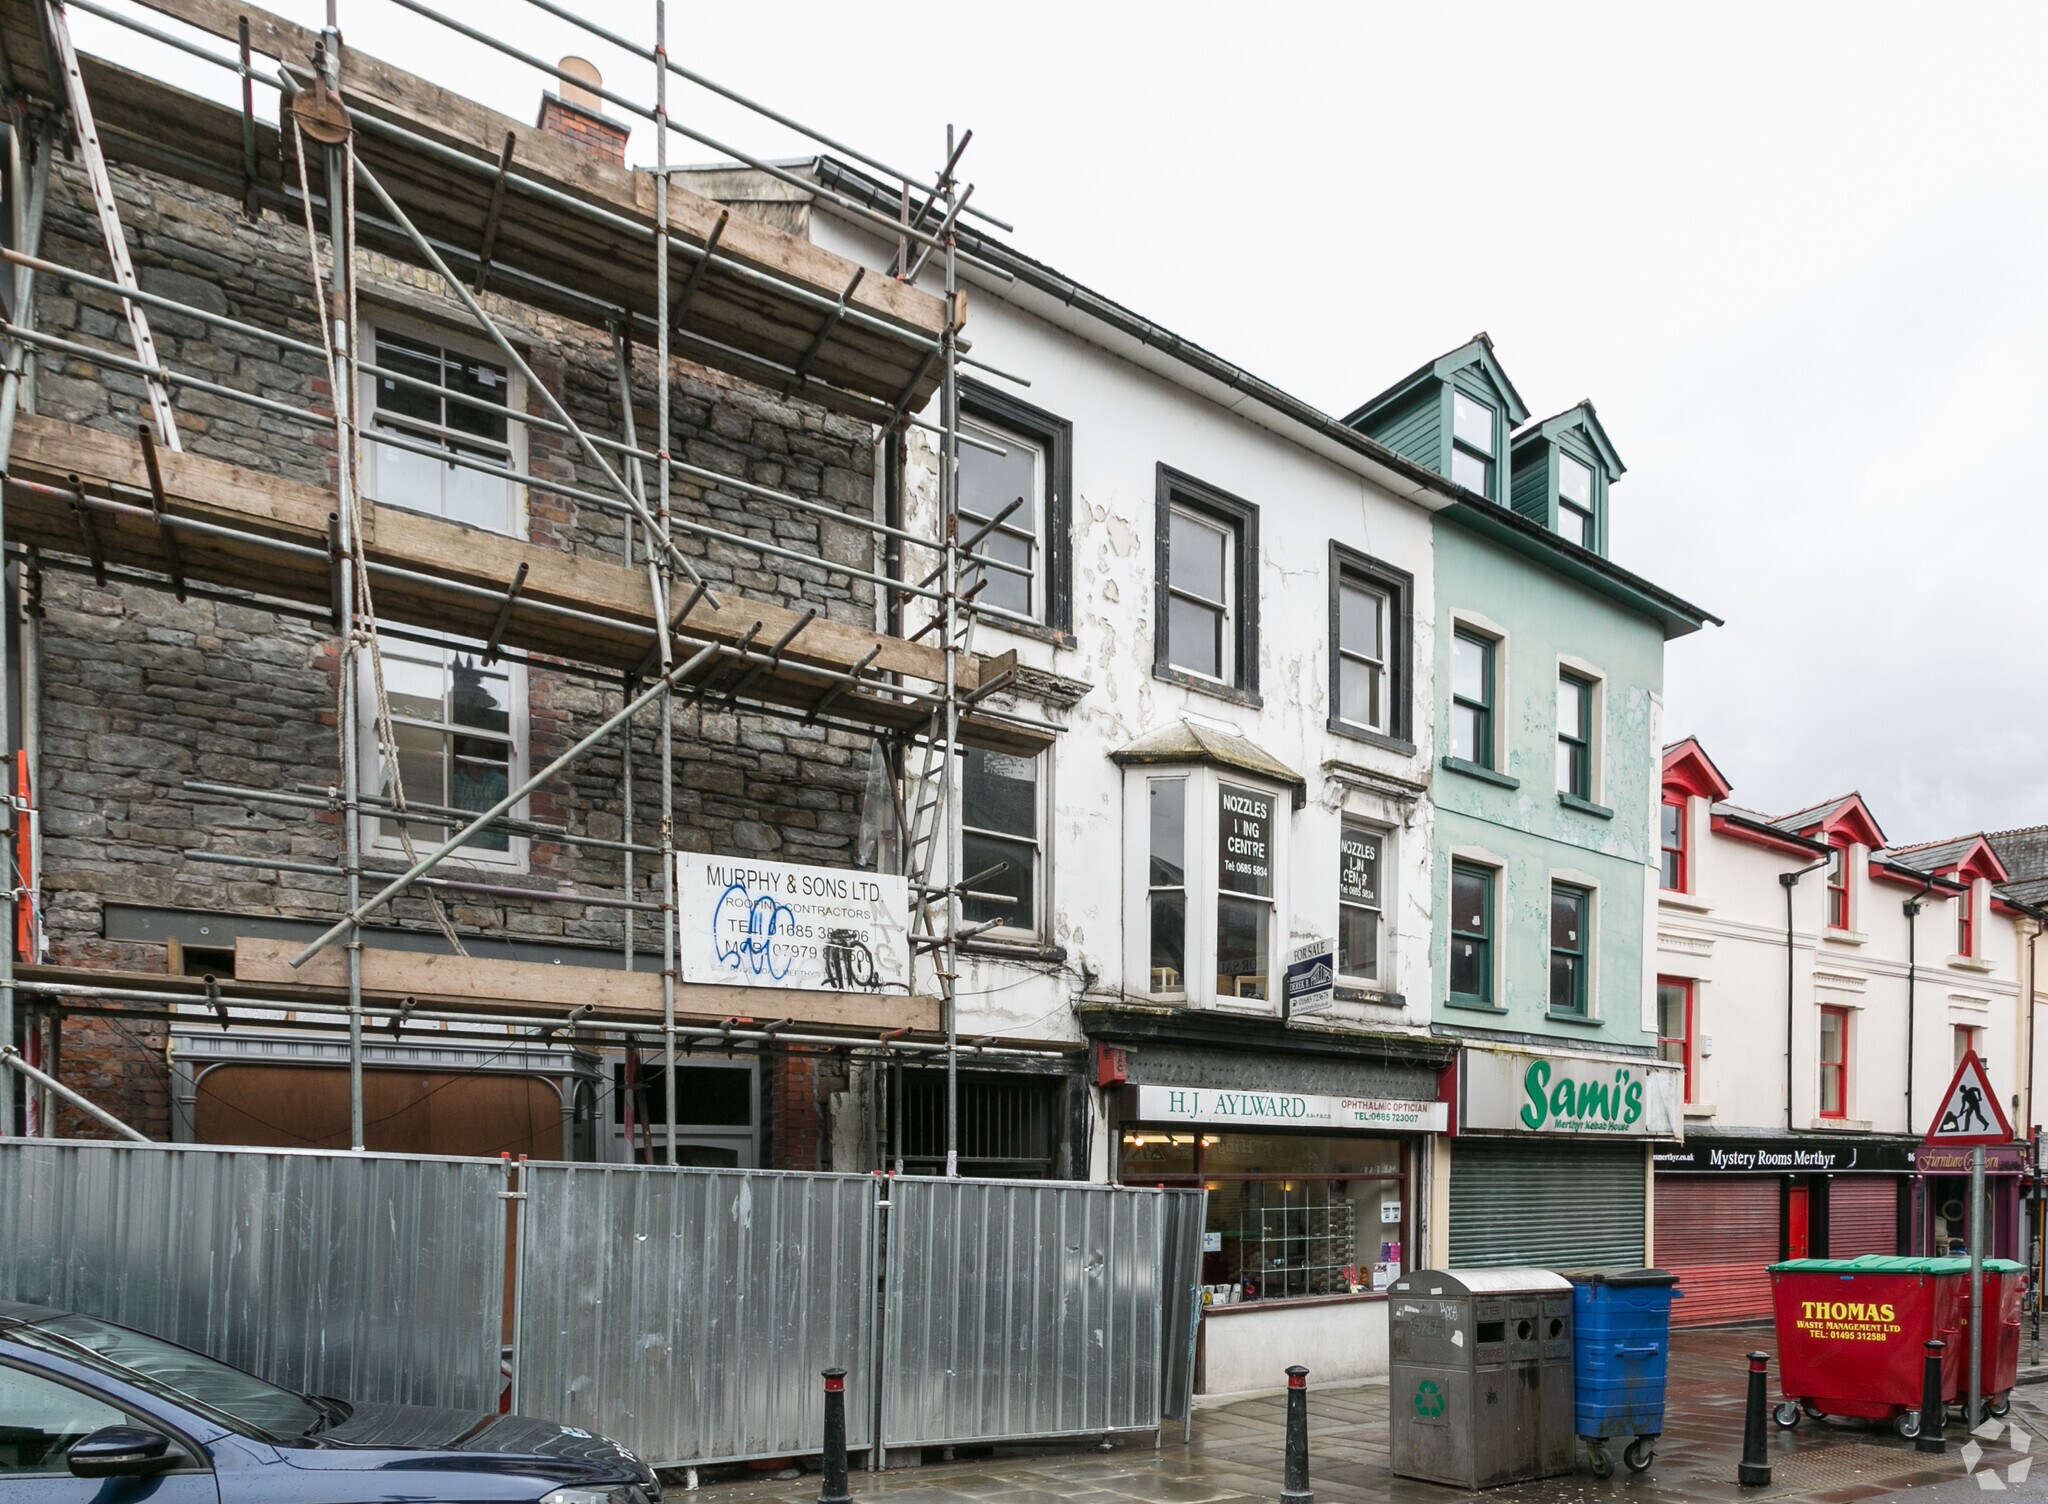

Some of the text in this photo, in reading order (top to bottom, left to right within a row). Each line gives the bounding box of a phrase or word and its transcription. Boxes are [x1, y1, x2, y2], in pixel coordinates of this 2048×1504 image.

[1223, 794, 1267, 819] NOZZLES
[1227, 836, 1265, 858] CENTRE
[1341, 839, 1375, 861] NOZZLES
[1236, 862, 1252, 875] 0685
[1252, 865, 1268, 878] 5834
[706, 865, 884, 903] MURPHY & SONS LTD.
[785, 902, 871, 919] CONTRACTORS
[1294, 941, 1325, 962] FOR SALE
[1520, 1059, 1643, 1130] Sami's
[1169, 1091, 1203, 1119] H.J.
[1214, 1094, 1306, 1118] AYLWARD
[1341, 1100, 1428, 1112] OPHTHALMIC OPTICIAN
[1392, 1113, 1419, 1123] 723007
[1554, 1119, 1629, 1131] Merthyr Kebab House
[1710, 1149, 1755, 1169] Mystery
[1758, 1150, 1792, 1165] Rooms
[1794, 1150, 1836, 1169] Merthyr
[1918, 1149, 1963, 1171] Furniture
[1801, 1302, 1895, 1322] THOMAS
[1809, 1330, 1887, 1341] TEL: 01495 312588
